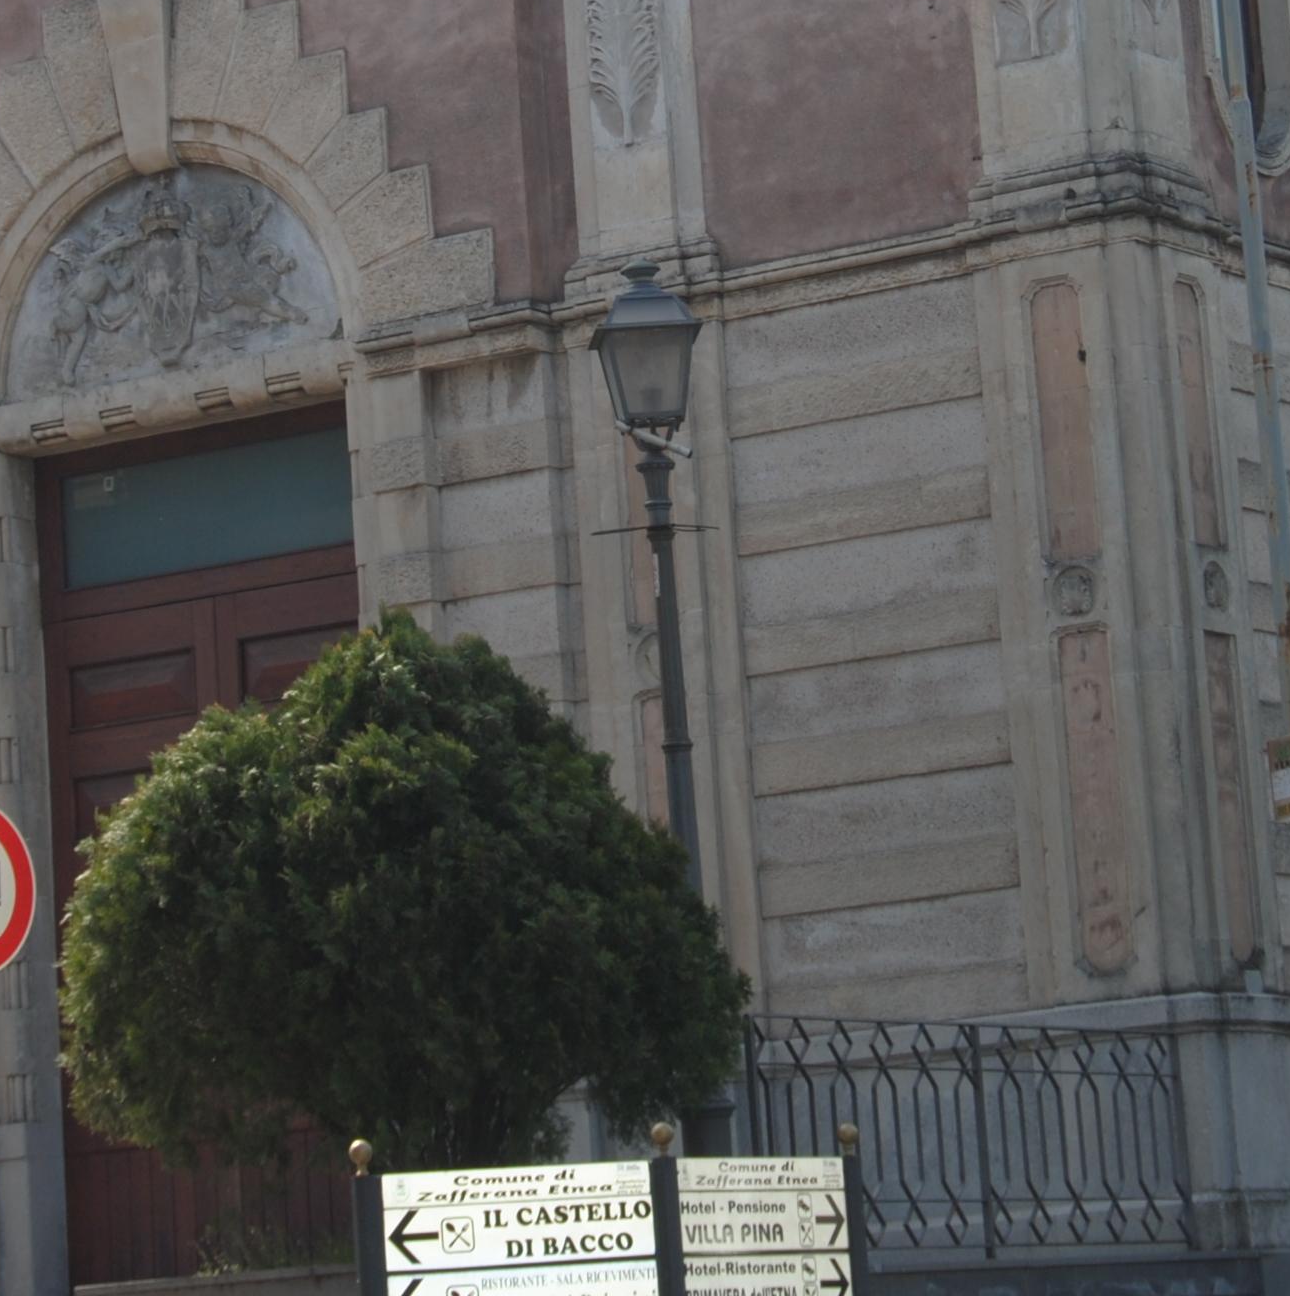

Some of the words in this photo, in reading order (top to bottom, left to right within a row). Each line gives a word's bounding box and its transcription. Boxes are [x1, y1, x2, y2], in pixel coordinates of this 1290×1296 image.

[718, 1161, 777, 1173] Comune
[781, 1161, 795, 1172] di
[453, 1173, 546, 1187] Comune
[553, 1168, 576, 1181] di
[695, 1175, 773, 1188] Zafferana
[777, 1175, 819, 1186] Etnea
[416, 1188, 538, 1203] Zafferana
[548, 1183, 614, 1195] Etnea
[483, 1209, 509, 1229] IL
[515, 1200, 651, 1227] CASTELLO
[681, 1201, 716, 1214] Hotel
[728, 1200, 786, 1214] Pensione
[685, 1225, 734, 1244] VILLA
[741, 1223, 785, 1243] PINA
[505, 1239, 533, 1259] DI
[542, 1232, 634, 1256] BACCO
[481, 1275, 548, 1290] RISTORANTE
[556, 1271, 584, 1286] SALA
[586, 1267, 657, 1285] RICEVIMENTI
[685, 1262, 797, 1276] Hotel-Ristorante
